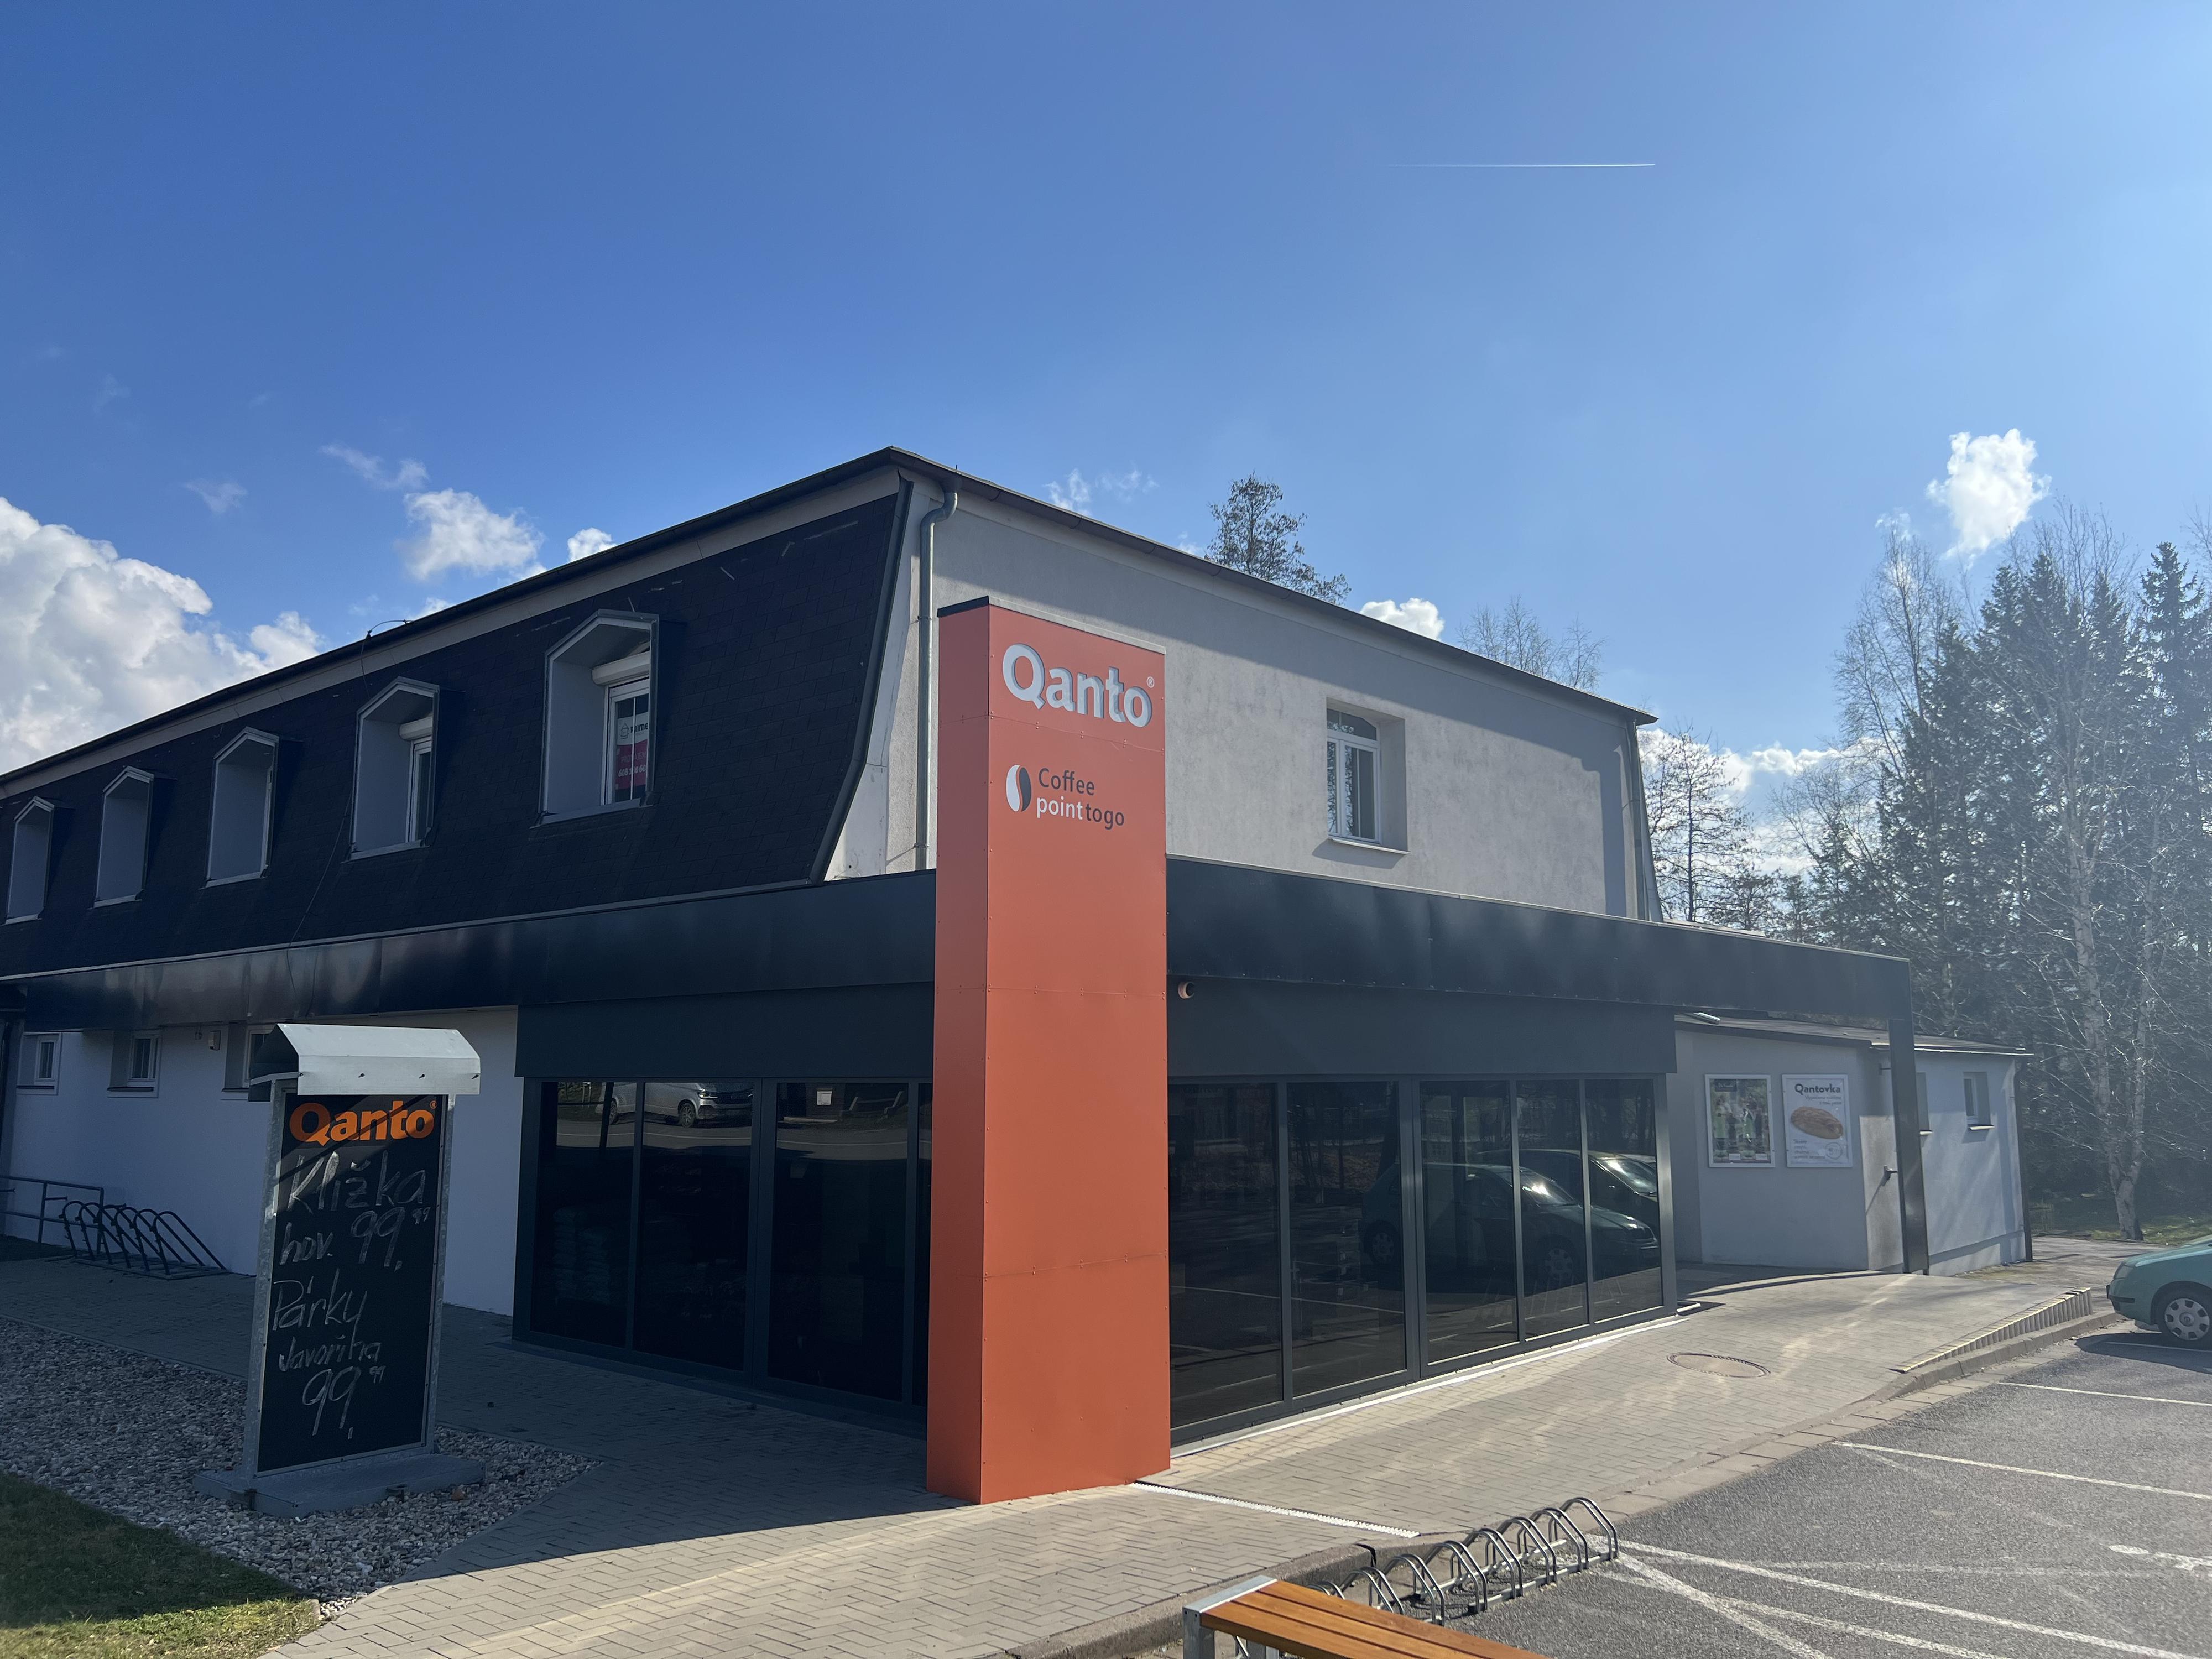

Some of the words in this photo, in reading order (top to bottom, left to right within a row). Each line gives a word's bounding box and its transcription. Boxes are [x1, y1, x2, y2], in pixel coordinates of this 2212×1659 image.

[1039, 768, 1095, 796] Coffee
[1794, 1083, 1840, 1095] Qantovka
[272, 1268, 367, 1349] Párky
